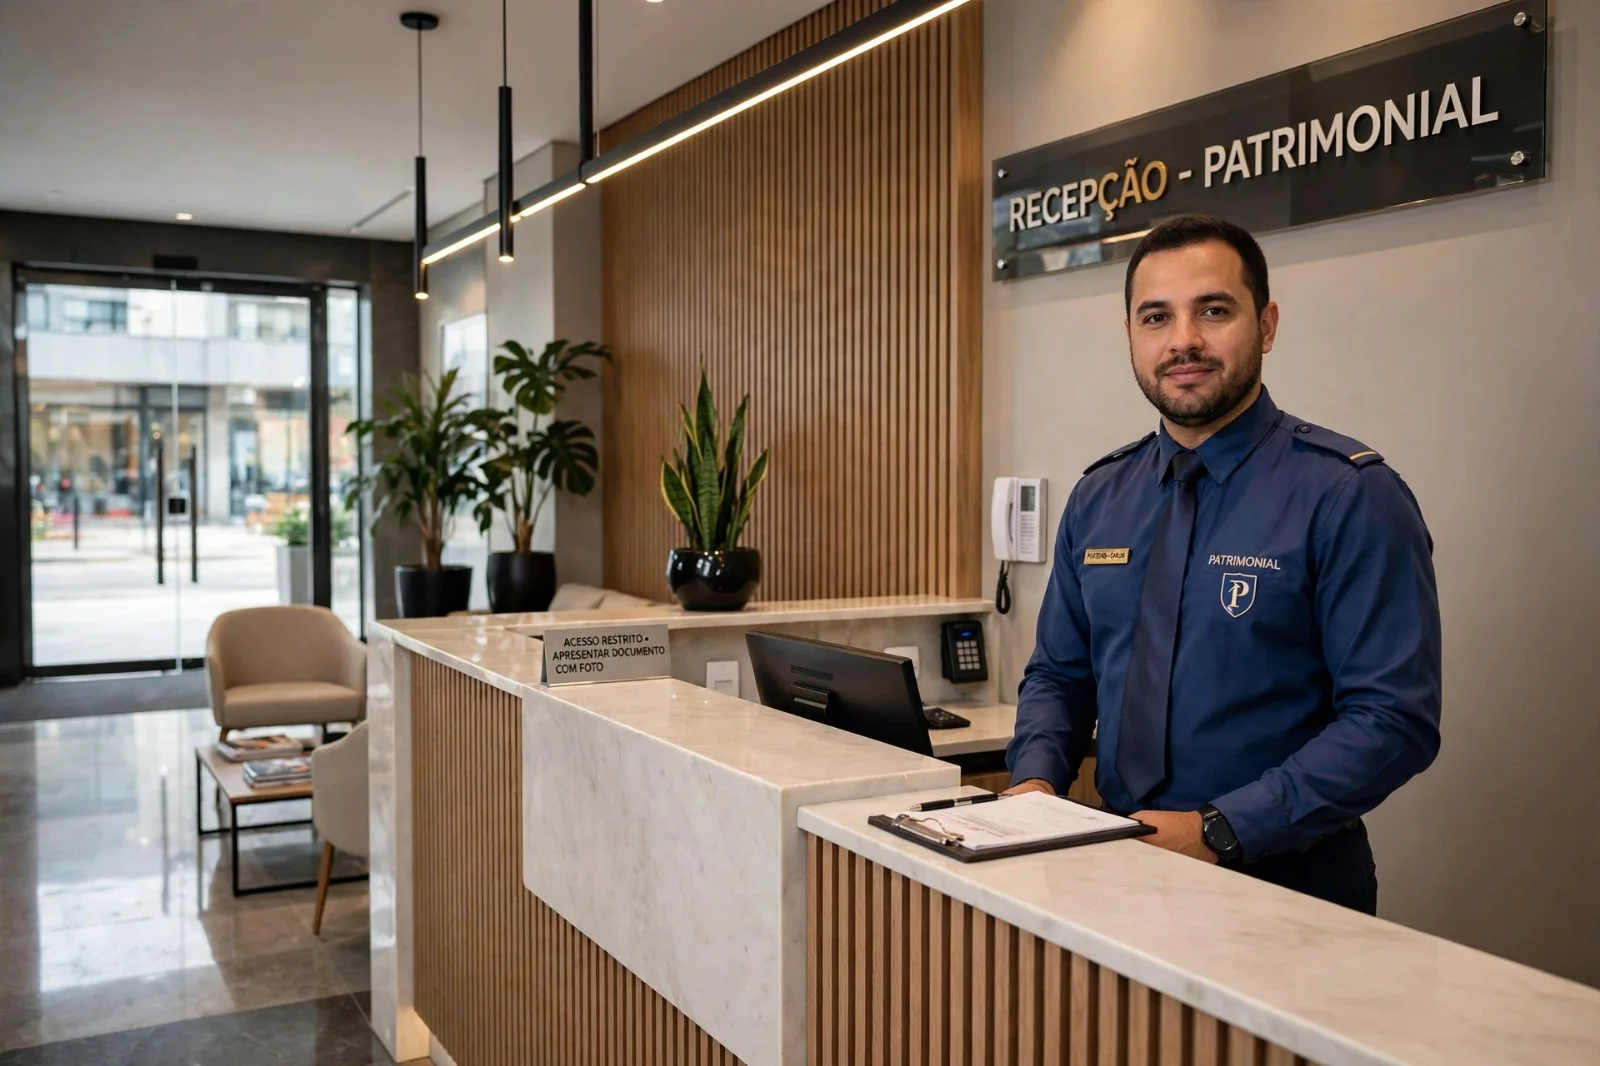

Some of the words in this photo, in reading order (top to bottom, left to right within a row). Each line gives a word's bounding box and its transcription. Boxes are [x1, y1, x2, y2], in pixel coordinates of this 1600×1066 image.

[1009, 157, 1168, 232] RECEPÇÃO
[1204, 75, 1499, 188] PATRIMONIAL
[1208, 554, 1281, 570] PATRIMONIAL
[564, 637, 600, 647] ACESSO
[602, 634, 643, 645] RESTRITO
[553, 649, 610, 660] APRESENTAR
[612, 646, 665, 657] DOCUMENTO
[556, 664, 577, 674] COM
[580, 662, 604, 672] FOTO
